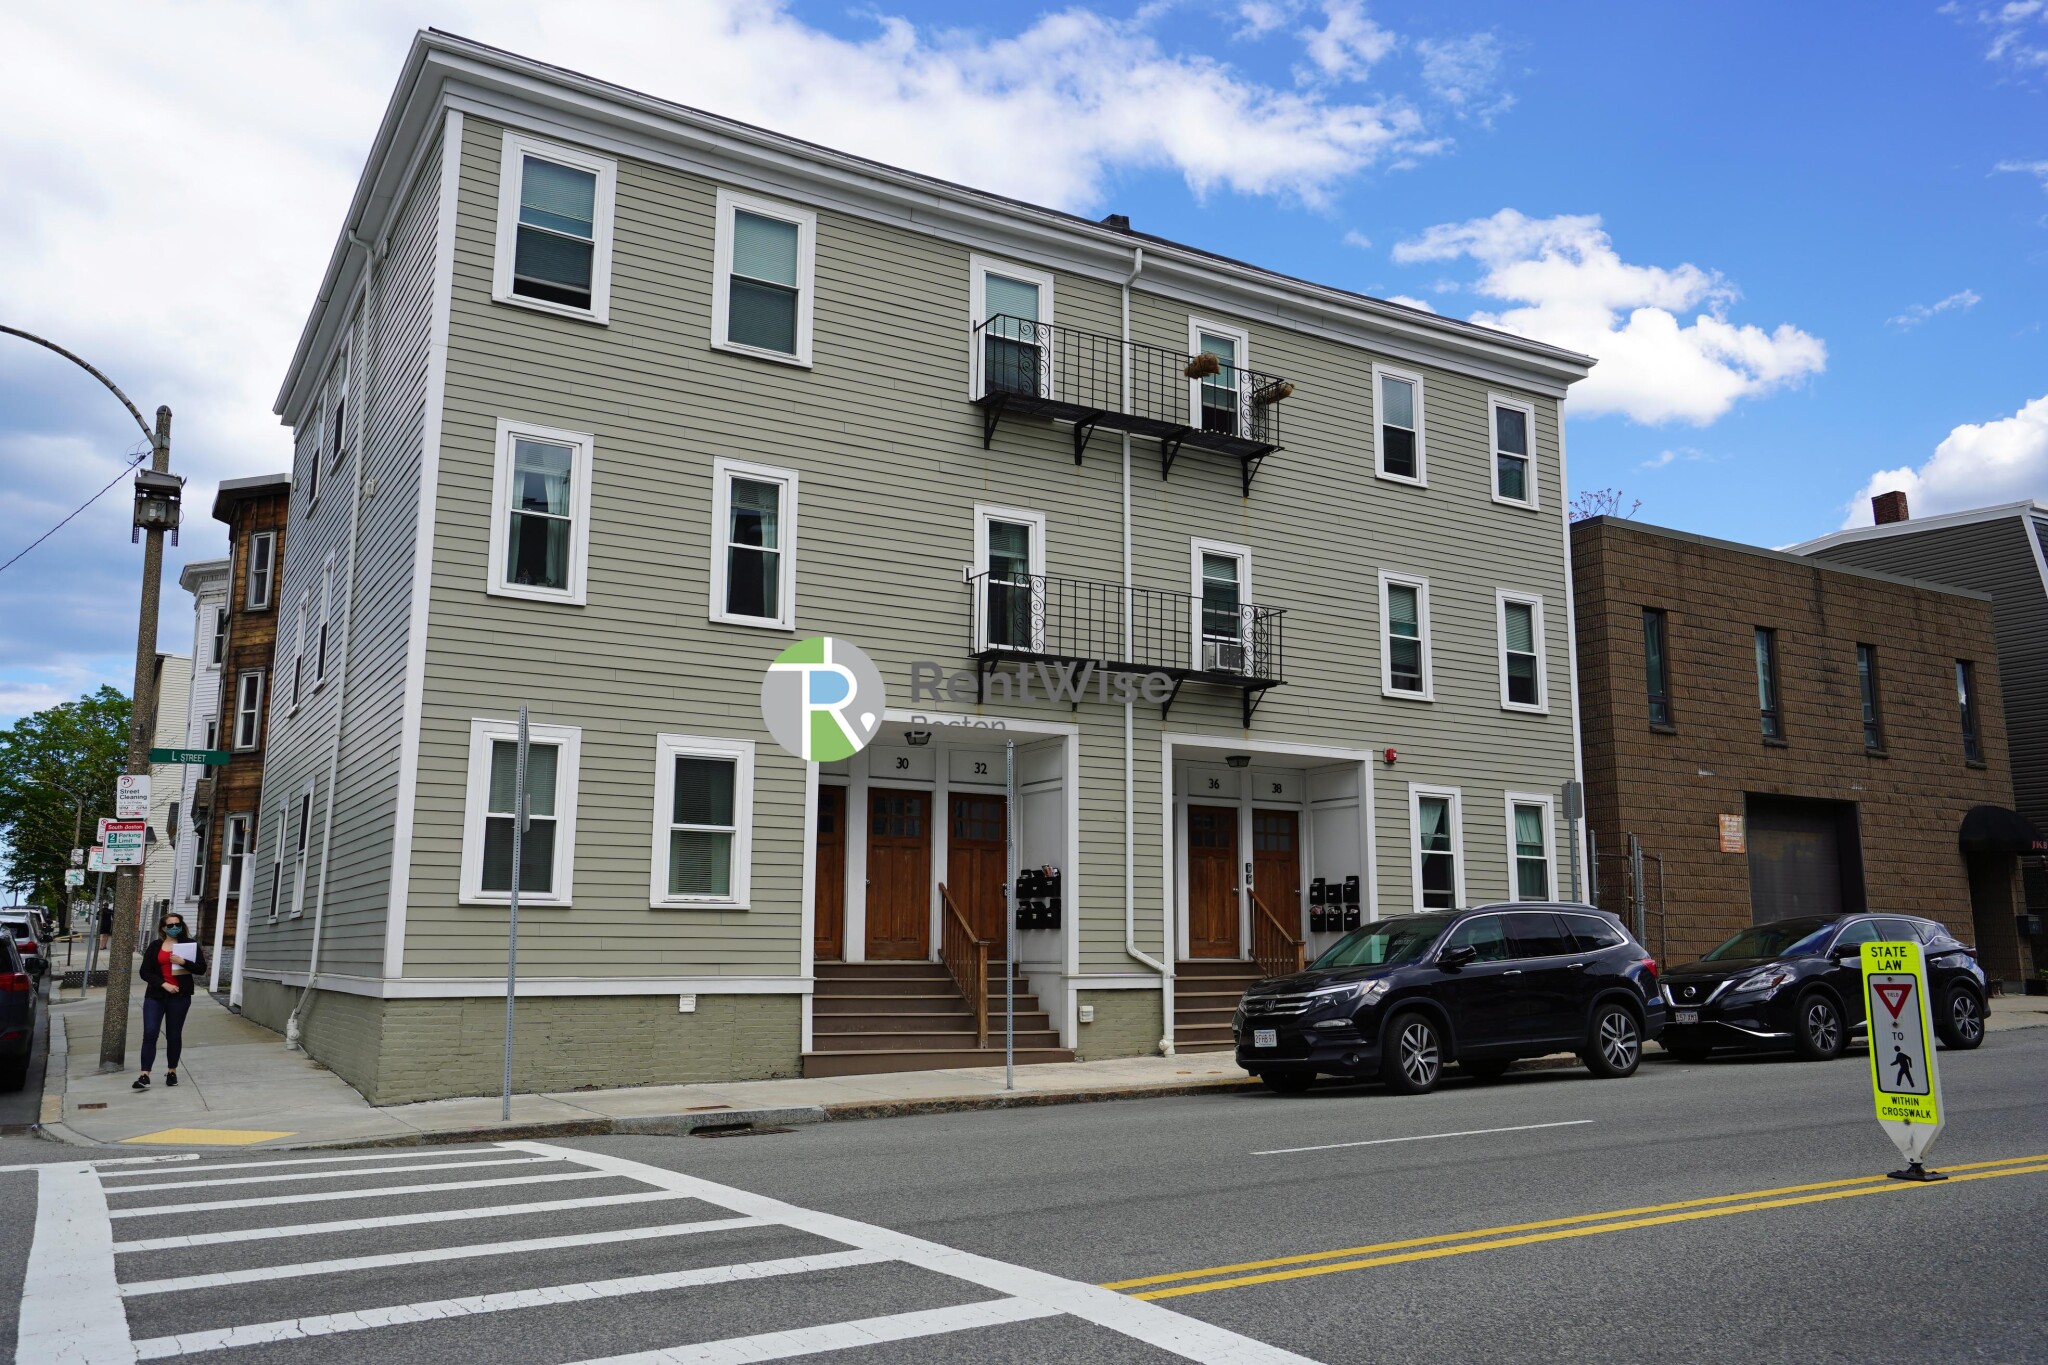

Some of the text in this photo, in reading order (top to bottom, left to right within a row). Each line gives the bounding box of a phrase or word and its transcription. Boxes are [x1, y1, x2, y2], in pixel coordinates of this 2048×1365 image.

[171, 750, 206, 762] L STREET
[896, 757, 909, 769] 30
[974, 762, 988, 774] 32
[1208, 778, 1220, 789] 36
[1271, 782, 1282, 793] 38
[109, 833, 116, 841] 2
[1871, 946, 1908, 957] STATE
[1877, 960, 1902, 971] LAW
[1891, 1032, 1904, 1041] TO
[1891, 1096, 1920, 1106] WITHIN
[1881, 1106, 1932, 1119] CROSSWALK
